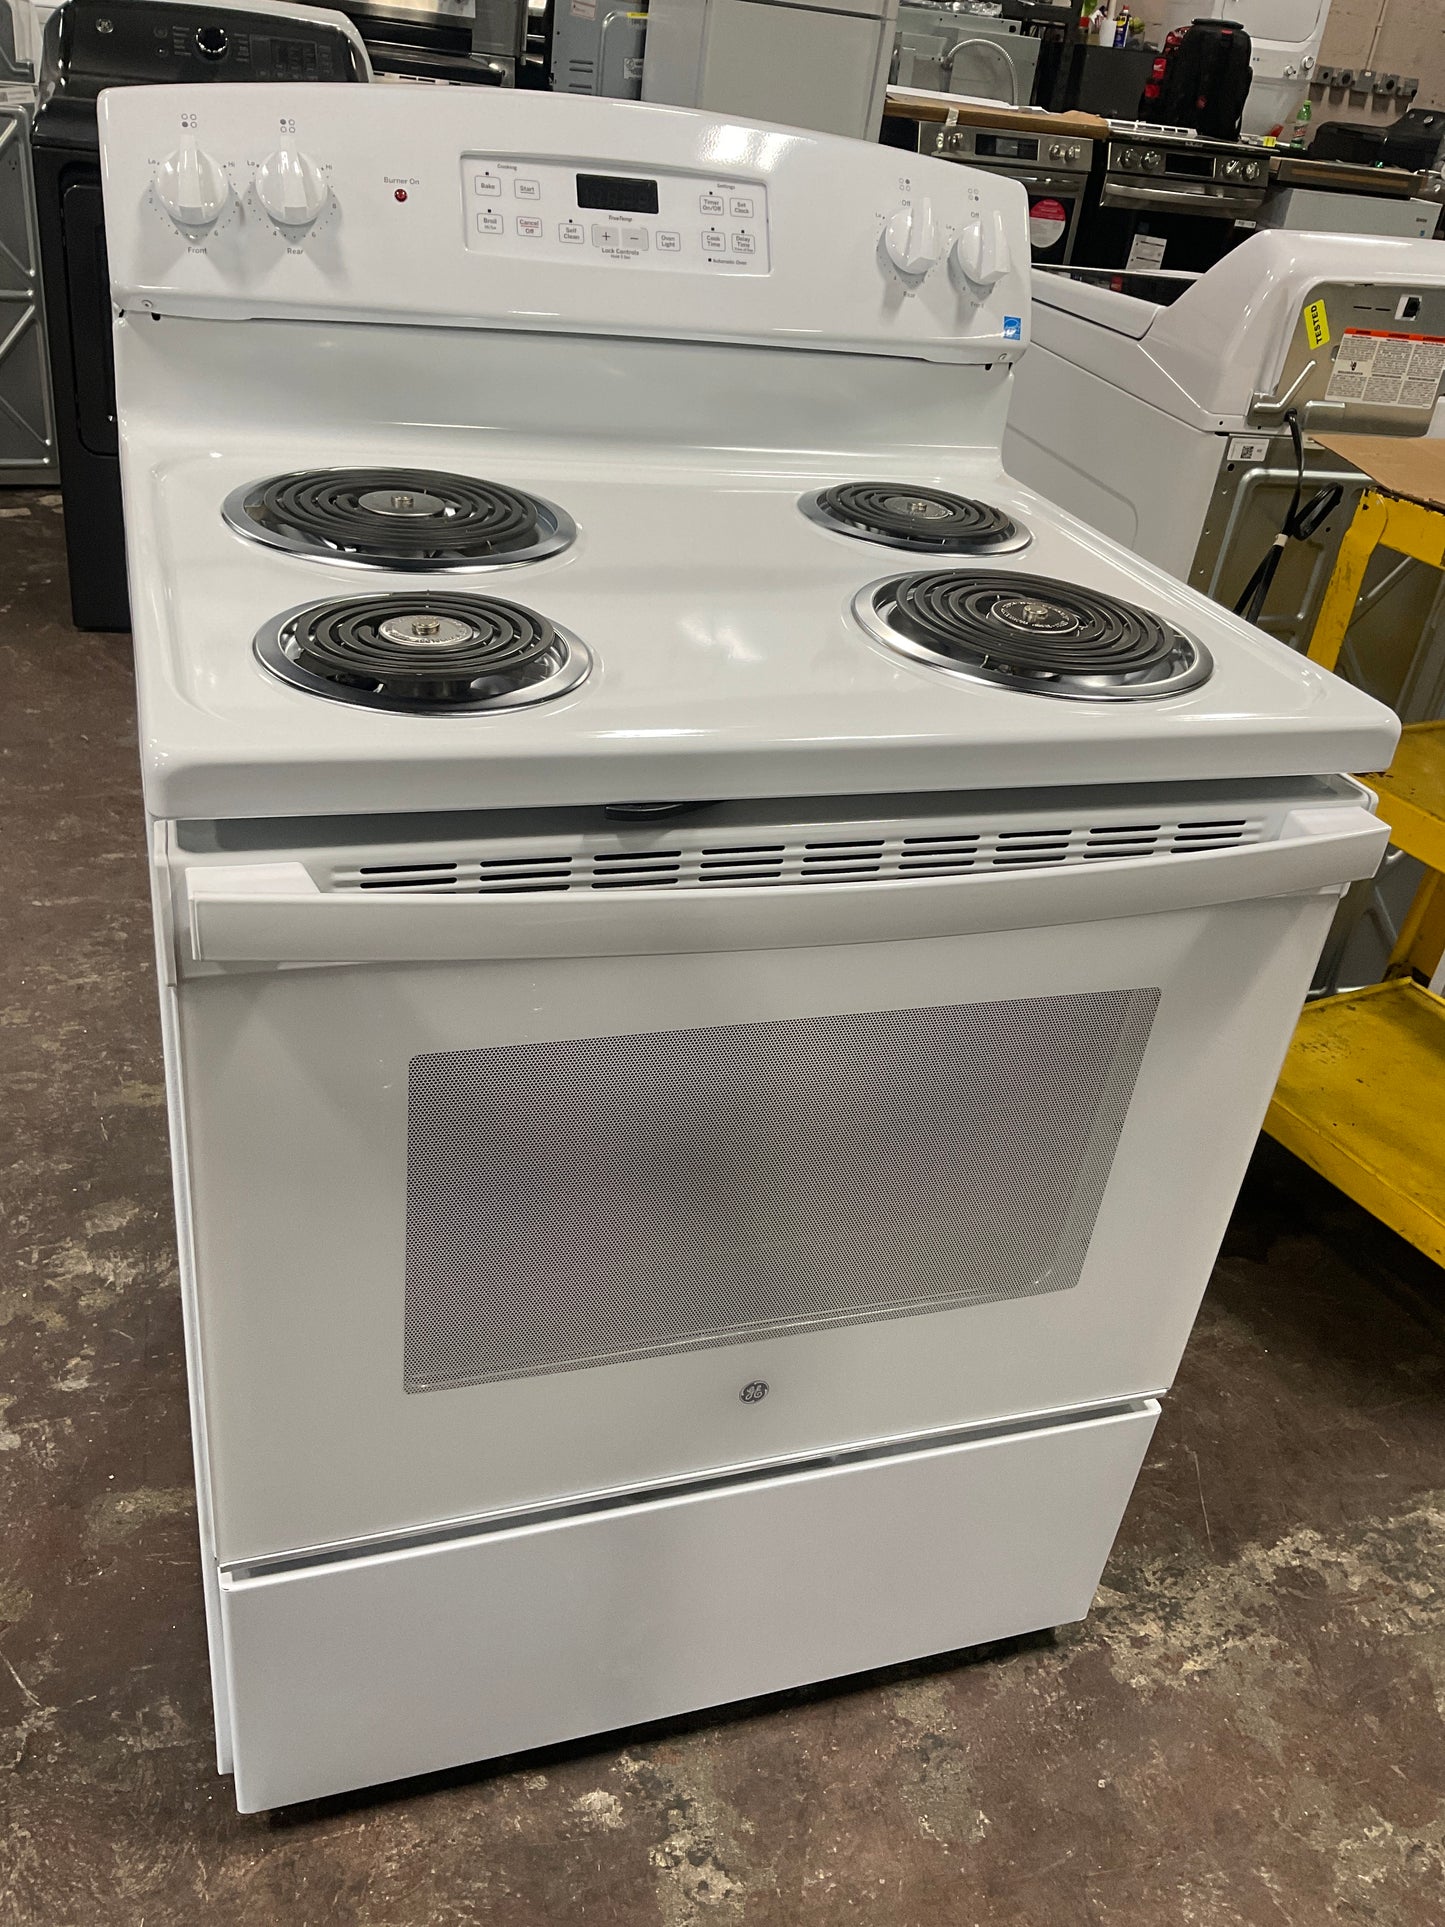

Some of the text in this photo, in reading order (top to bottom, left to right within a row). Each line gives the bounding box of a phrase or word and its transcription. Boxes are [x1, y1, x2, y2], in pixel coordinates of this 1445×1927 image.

[497, 163, 517, 171] Cooking
[383, 176, 408, 184] Burner
[187, 247, 208, 255] Front
[287, 247, 304, 255] Rear
[616, 248, 639, 256] Controls
[1310, 304, 1323, 345] TESTED
